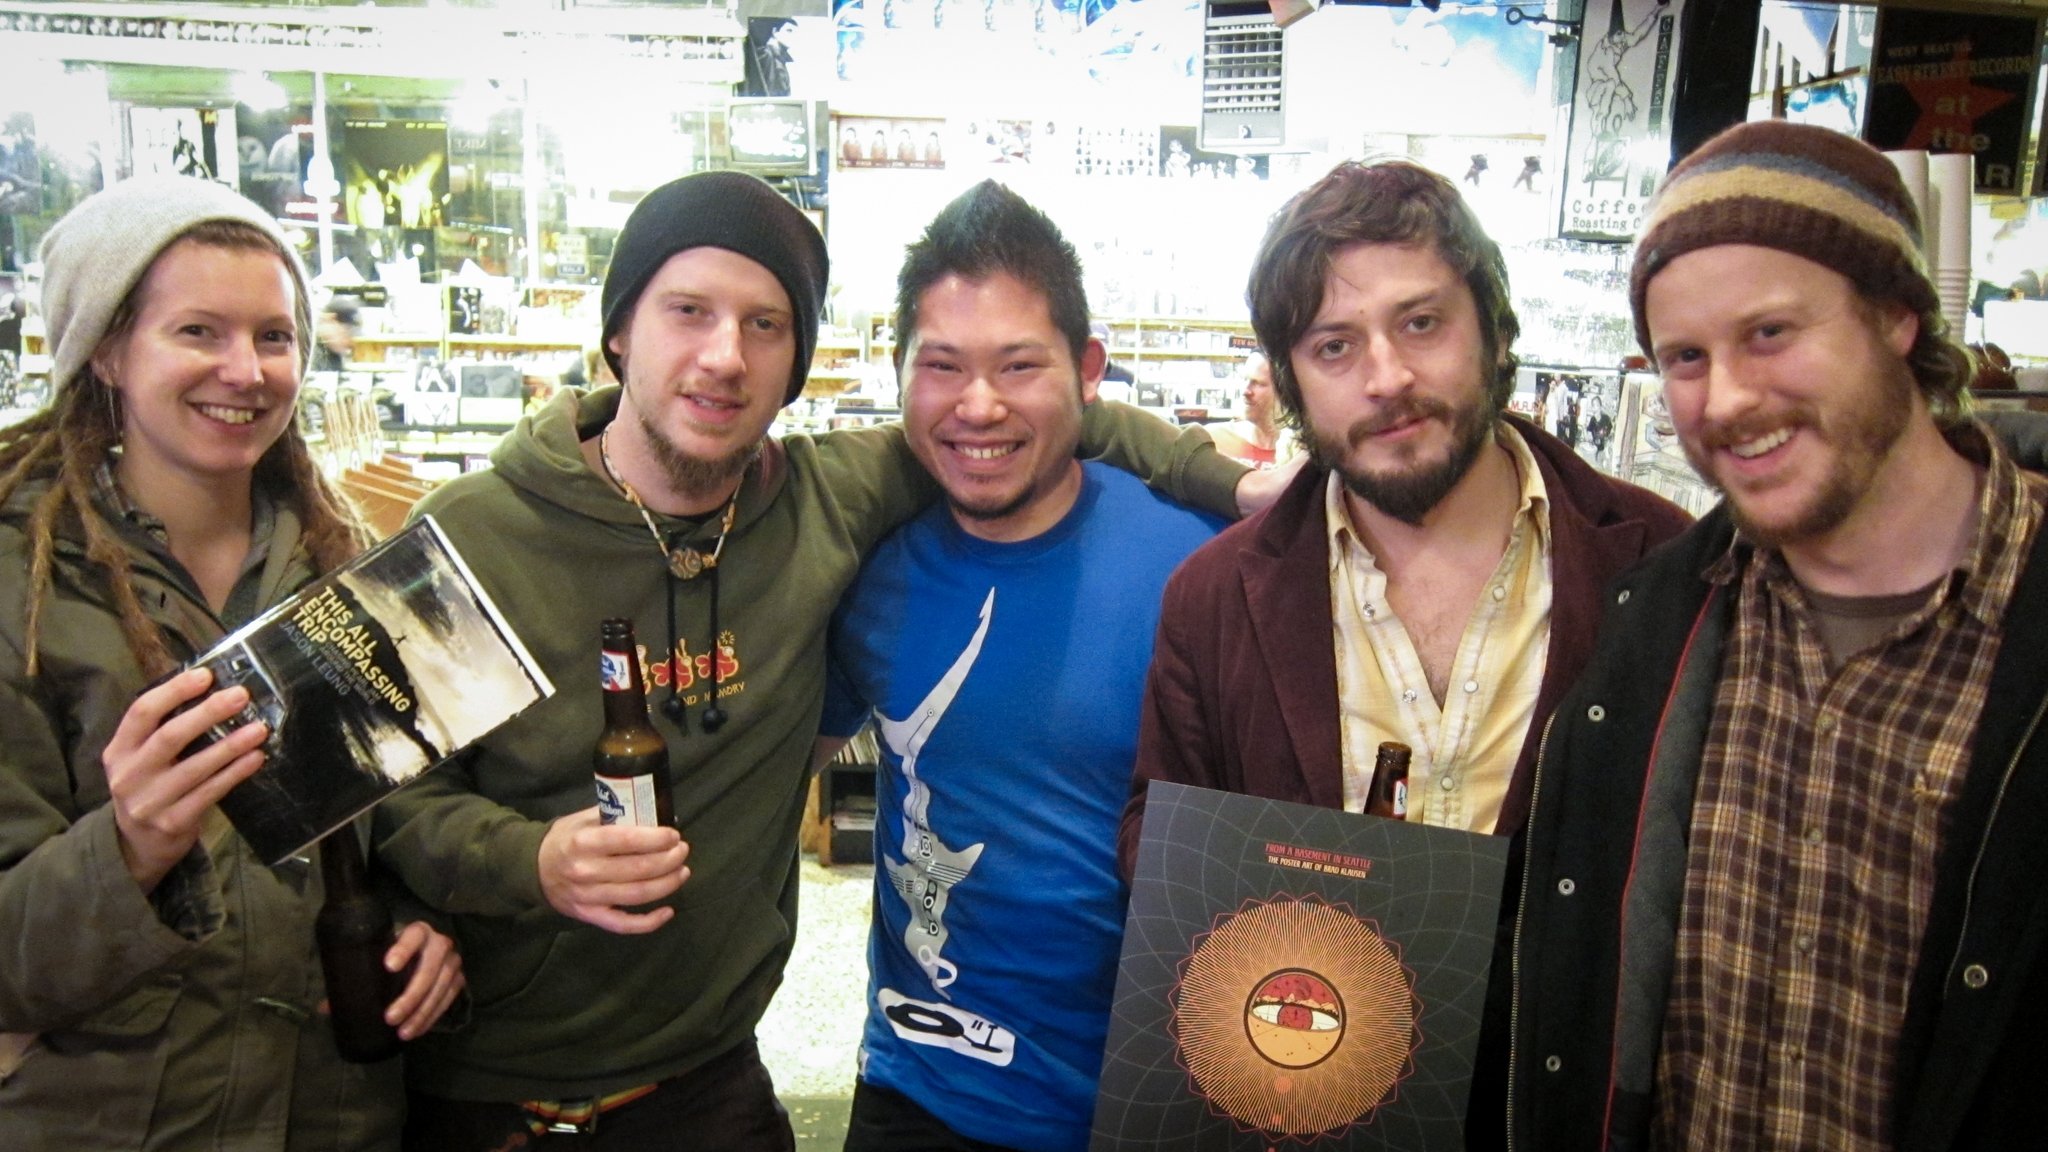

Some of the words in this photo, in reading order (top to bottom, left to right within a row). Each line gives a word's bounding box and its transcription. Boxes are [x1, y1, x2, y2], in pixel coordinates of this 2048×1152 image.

[1935, 96, 1969, 116] at
[1932, 127, 1991, 151] the
[1572, 216, 1628, 233] Roasting
[292, 606, 327, 643] TRIP
[319, 585, 354, 625] THIS
[347, 624, 378, 657] ALL
[279, 620, 315, 658] JASON
[312, 655, 351, 696] LEUNG
[304, 597, 411, 712] ENCOMPASSING
[1265, 842, 1285, 854] FROM
[1287, 846, 1293, 855] A
[1294, 847, 1331, 862] BASEMENT
[1333, 854, 1342, 863] IN
[1343, 855, 1372, 869] SEATTLE
[1268, 855, 1279, 865] THE
[1280, 857, 1301, 868] POSTER
[1301, 860, 1314, 870] ART
[1314, 863, 1322, 872] OF
[1323, 864, 1340, 875] BRAD
[1340, 867, 1366, 879] KLAUSEN
